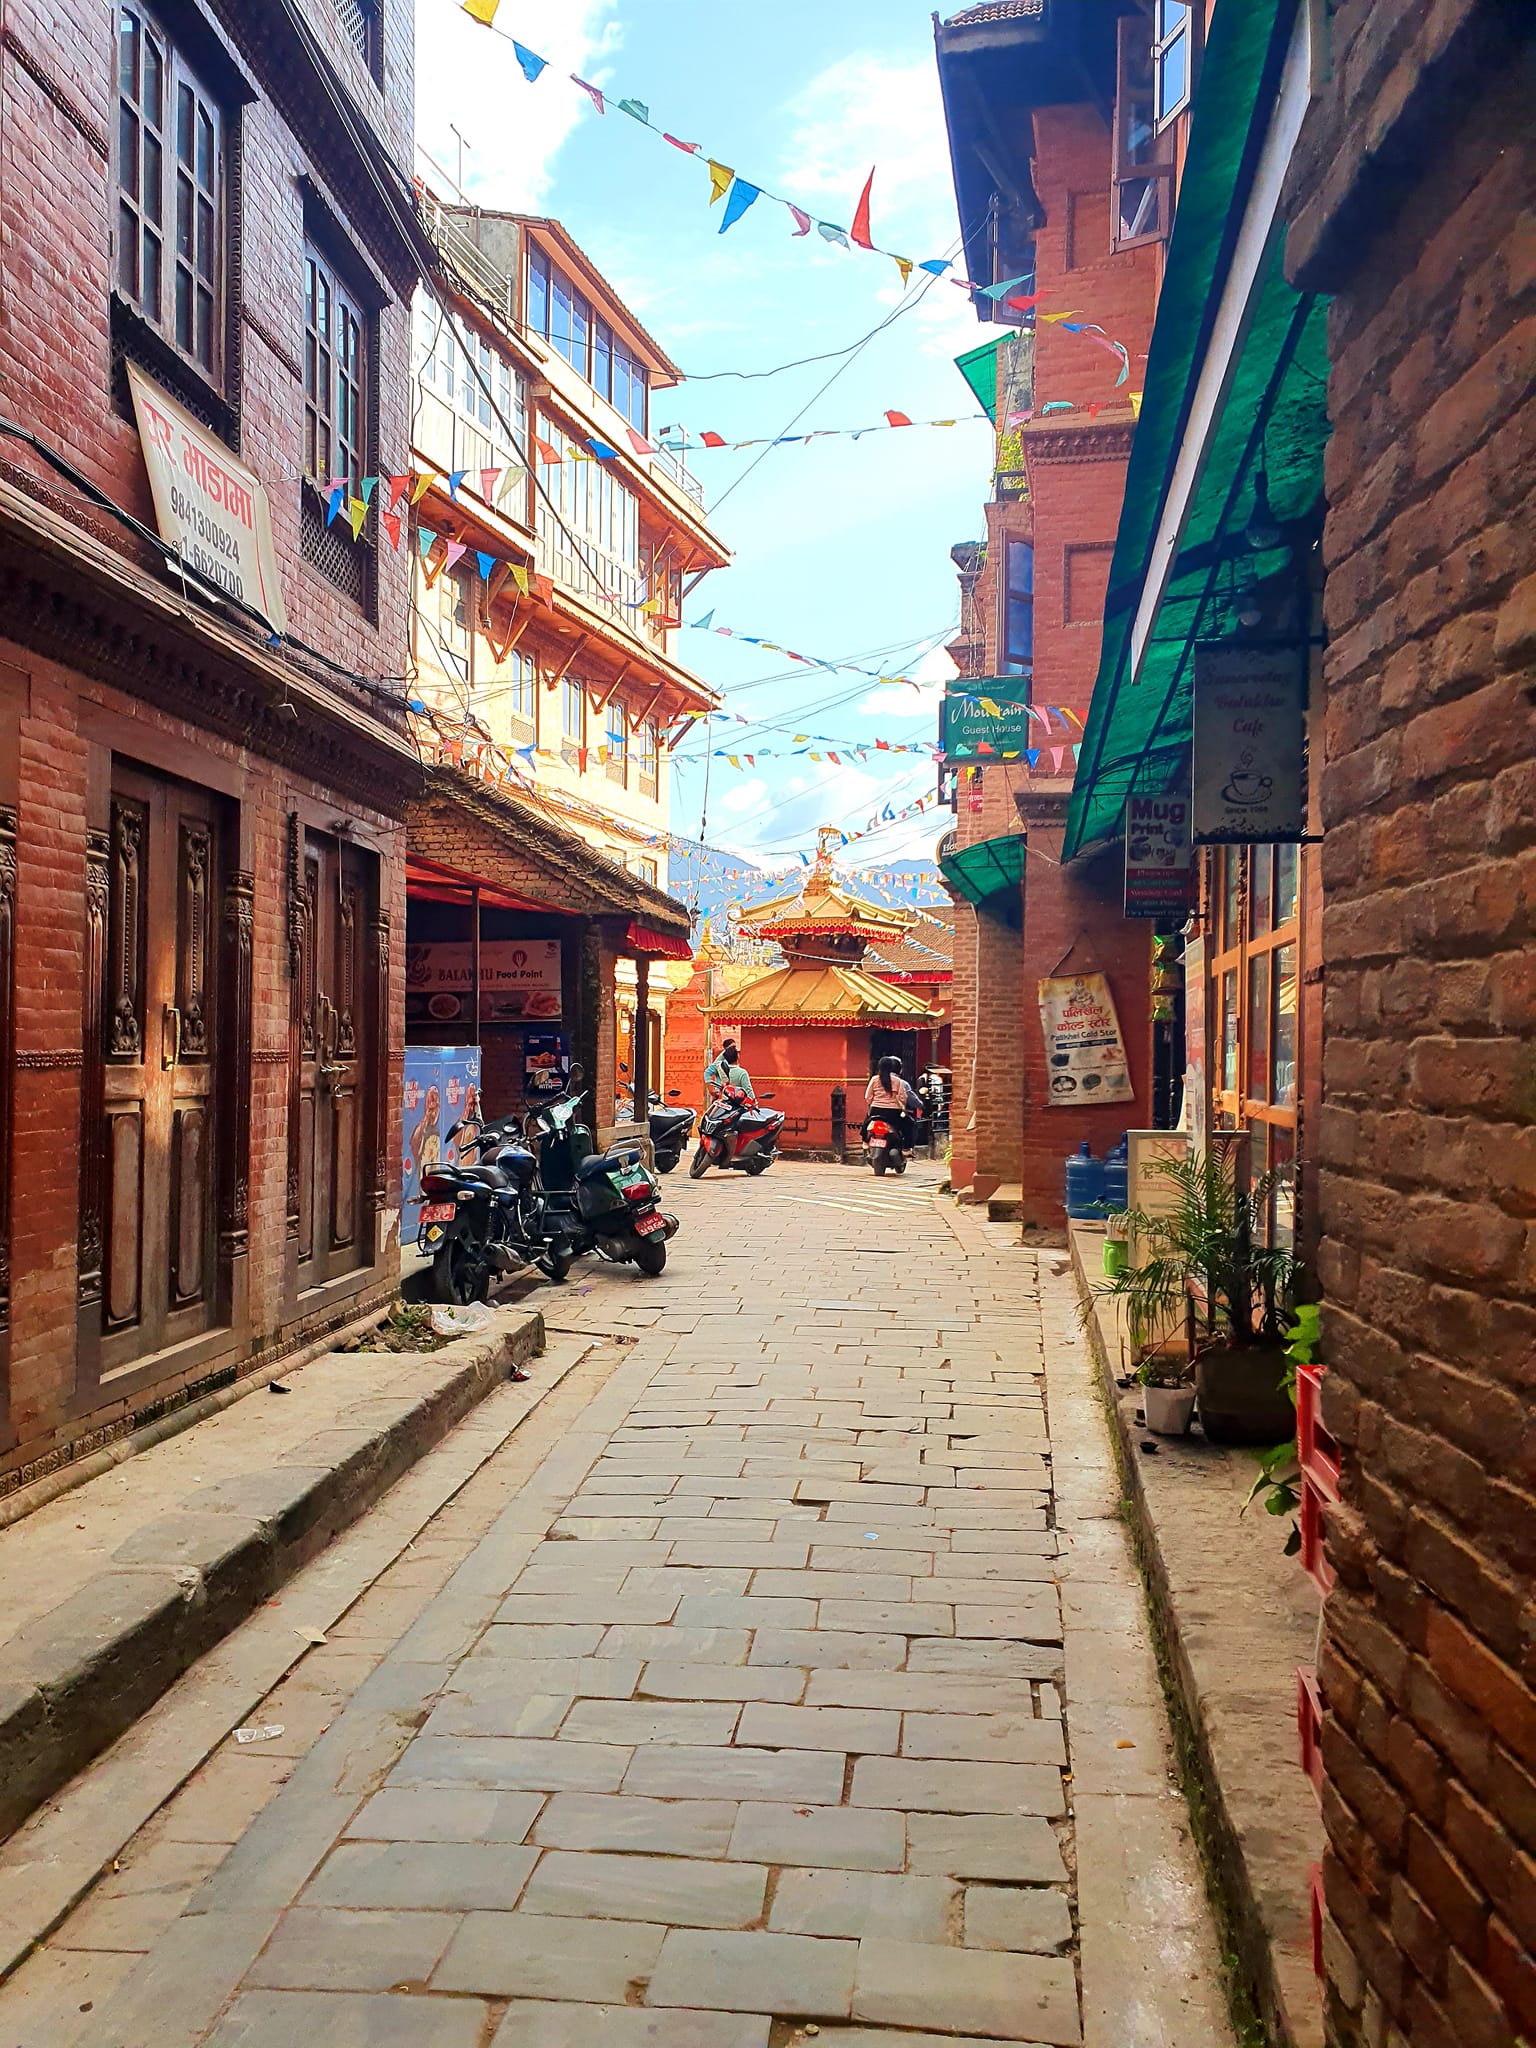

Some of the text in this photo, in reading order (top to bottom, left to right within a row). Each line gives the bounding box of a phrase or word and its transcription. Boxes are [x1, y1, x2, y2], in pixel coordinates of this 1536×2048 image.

[181, 434, 253, 530] भाडामा
[170, 485, 241, 565] 9841300924
[176, 535, 244, 601] 1-6620700
[951, 697, 1022, 724] Mouain
[962, 724, 1022, 735] Guest House
[1131, 800, 1186, 824] Mug
[1131, 823, 1163, 834] Print
[496, 970, 517, 979] Food
[520, 969, 543, 978] Point
[1081, 1030, 1098, 1038] Cold
